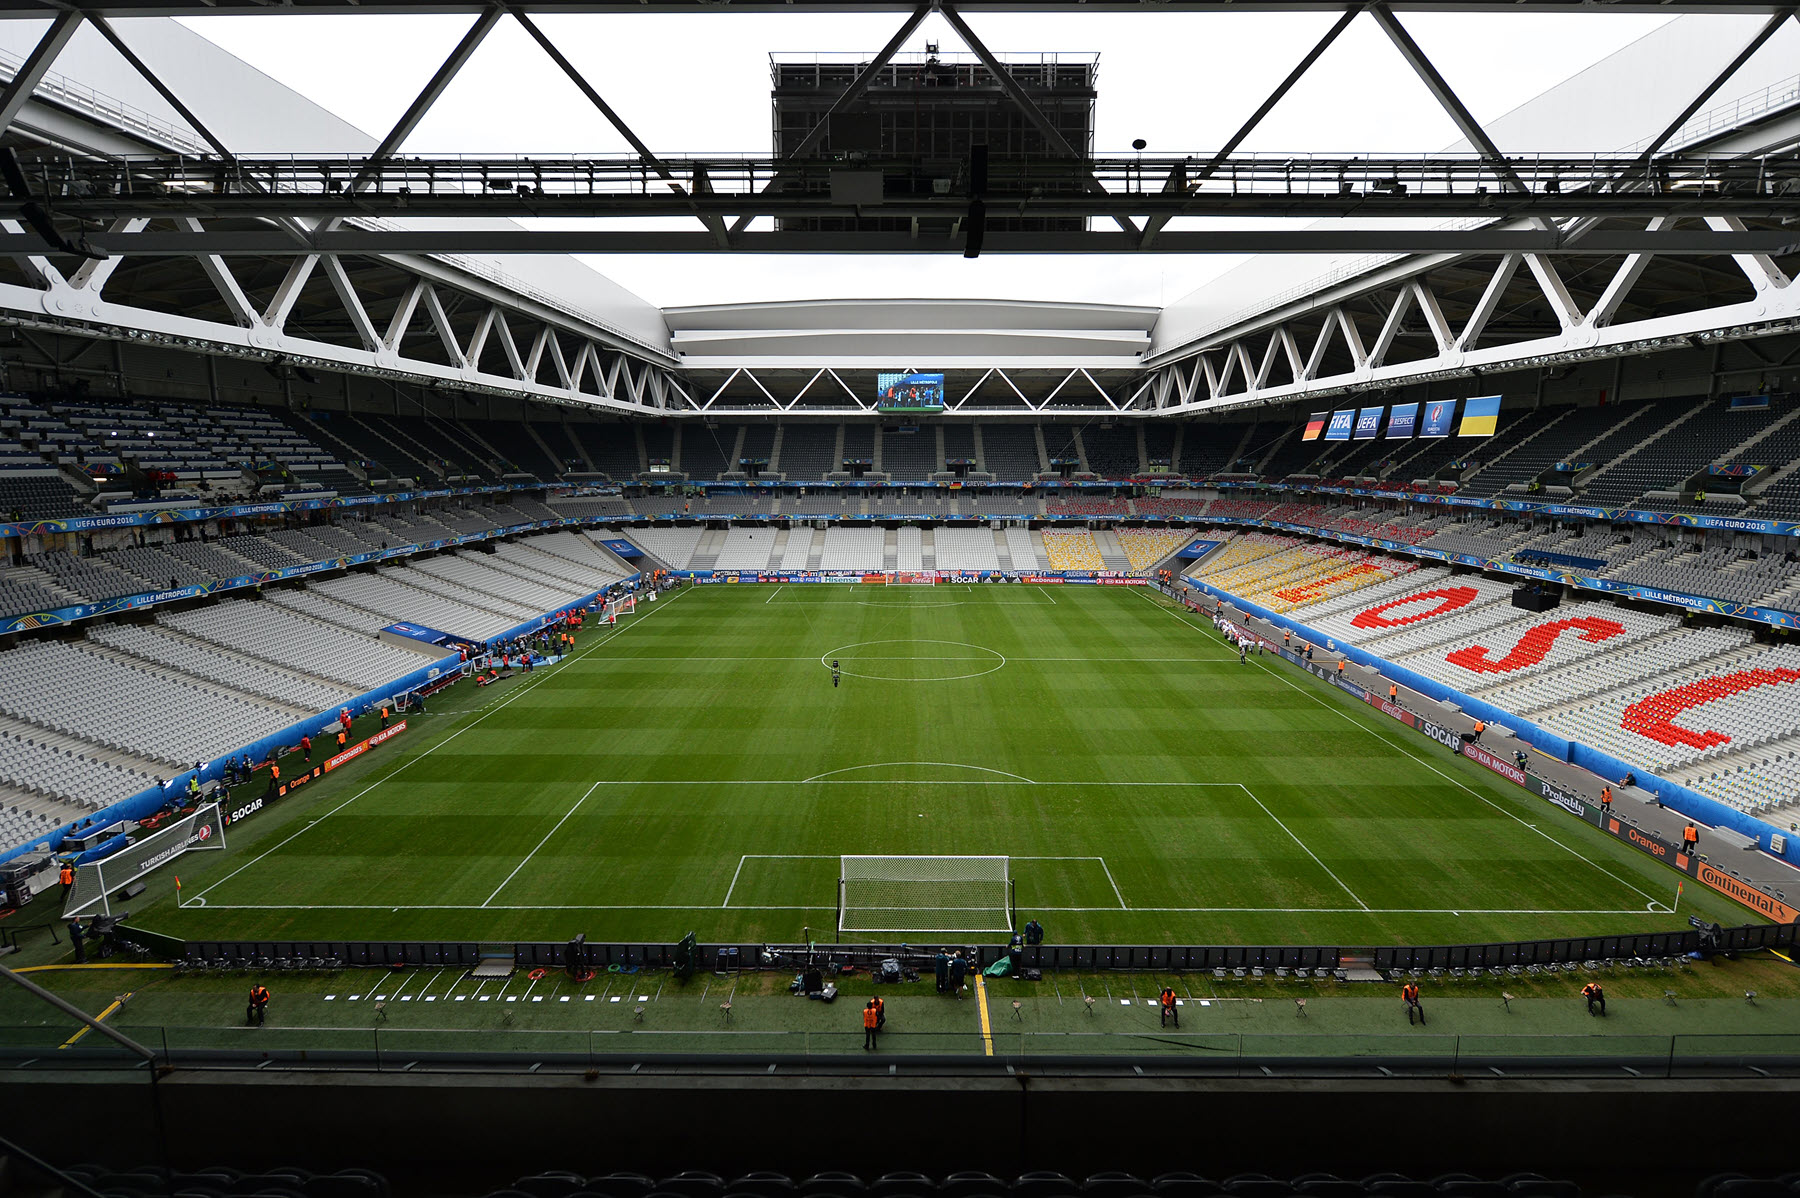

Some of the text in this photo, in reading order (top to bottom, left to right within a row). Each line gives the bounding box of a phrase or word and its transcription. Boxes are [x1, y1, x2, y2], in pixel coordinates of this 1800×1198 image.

[1329, 414, 1350, 429] FIFA
[1356, 417, 1377, 429] UEFA
[1394, 417, 1415, 425] RESPECT
[251, 505, 278, 513] MÉTROPOLE
[1567, 507, 1596, 516] MÉTROPOLE
[75, 520, 96, 528] UEFA
[1705, 519, 1766, 530] UEFA EURO 2016
[1519, 567, 1532, 575] EURO
[1532, 569, 1545, 577] 2016
[137, 587, 192, 604] LILLE MÉTROPOLE
[1645, 590, 1703, 607] LILLE MÉTROPOLE
[1424, 722, 1460, 751] SOCAR
[331, 745, 363, 767] McDonald's
[1478, 752, 1525, 784] KIA MOTORS
[290, 774, 310, 789] Orange
[1541, 781, 1585, 817] Probably
[231, 798, 263, 822] SOCAR
[1628, 829, 1666, 856] Orange
[140, 833, 199, 870] TURKISH AIRLINES
[1702, 868, 1774, 914] Continental
